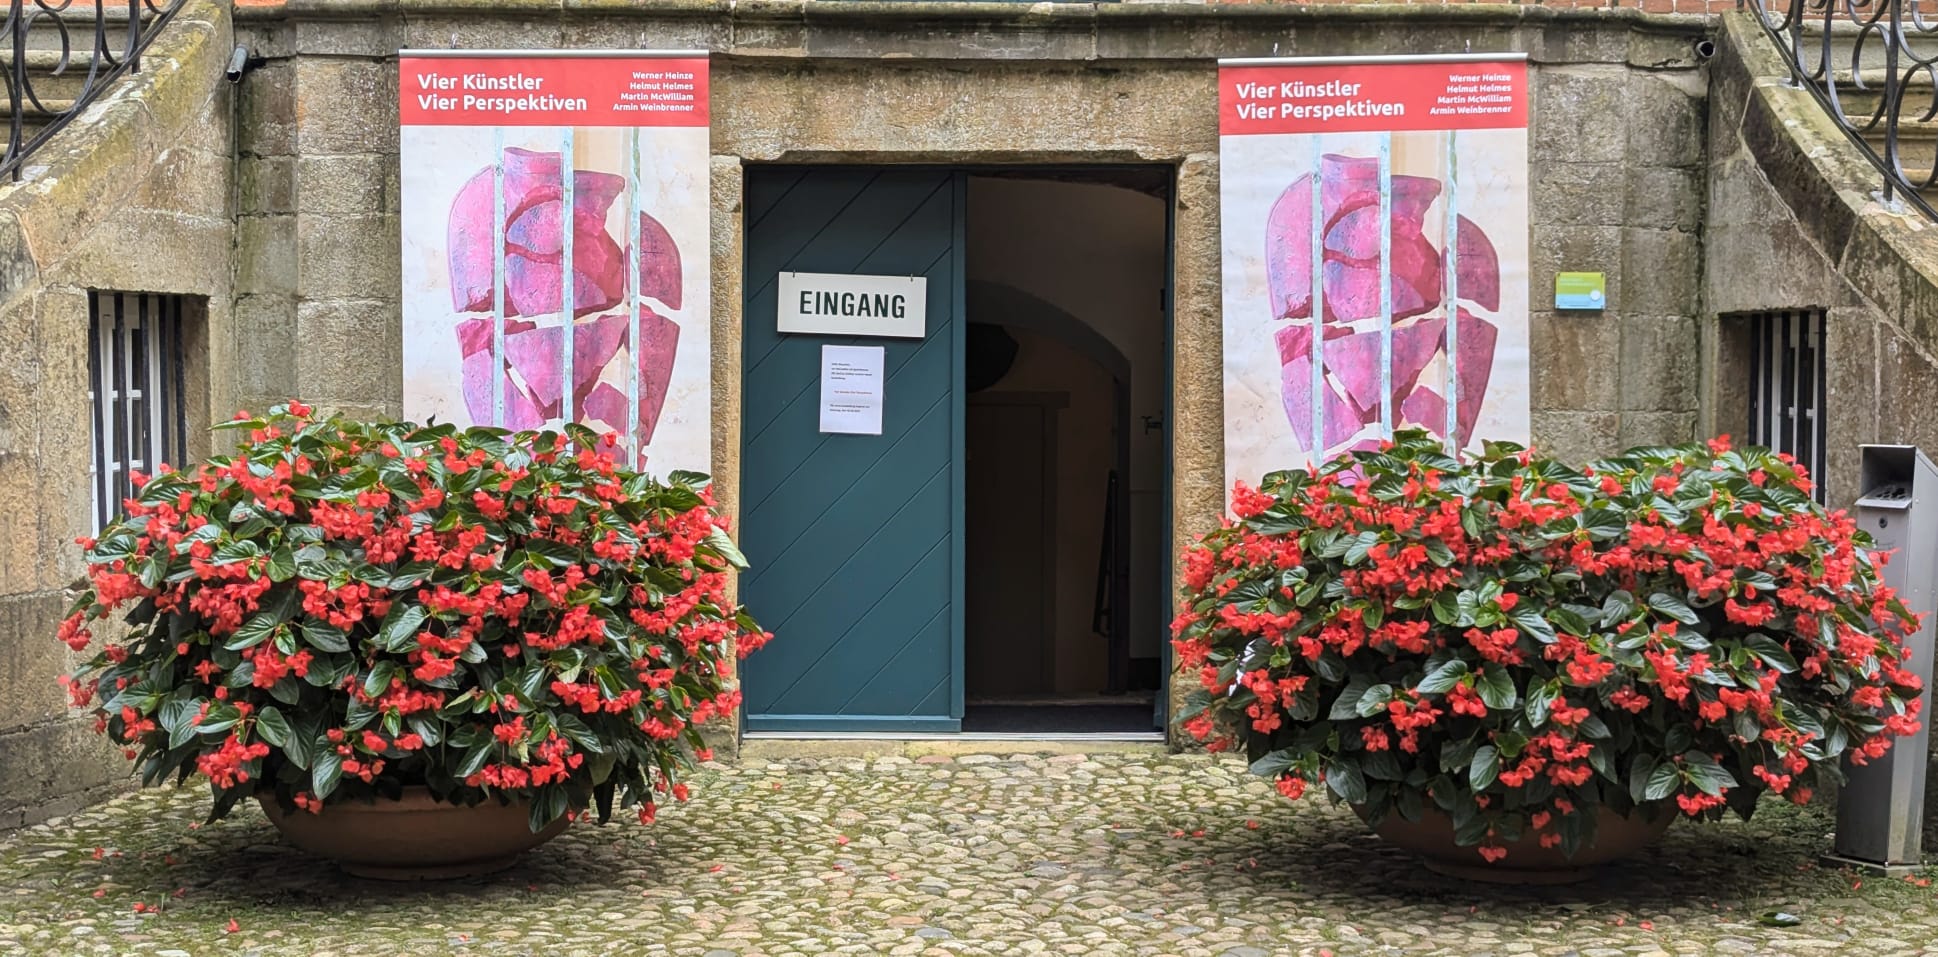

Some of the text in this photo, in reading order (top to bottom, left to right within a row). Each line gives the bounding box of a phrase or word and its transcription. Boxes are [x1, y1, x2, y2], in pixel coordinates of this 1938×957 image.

[632, 72, 694, 80] Werner Heinze
[1449, 73, 1511, 83] Werner Heinze
[418, 73, 544, 90] Vier Künstler
[630, 82, 694, 90] Helmut Helmes
[1236, 81, 1361, 99] Vier Künstler
[1447, 84, 1511, 93] Helmut Helmes
[621, 92, 694, 100] Martin McWilliam
[1437, 94, 1511, 104] Martin McWilliam
[418, 94, 587, 113] Vier Perspektiven
[613, 103, 694, 111] Armin Weinbrenner
[1236, 100, 1404, 121] Vier Perspektiven
[1430, 105, 1512, 115] Armin Weinbrenner
[800, 291, 905, 318] EINGANG
